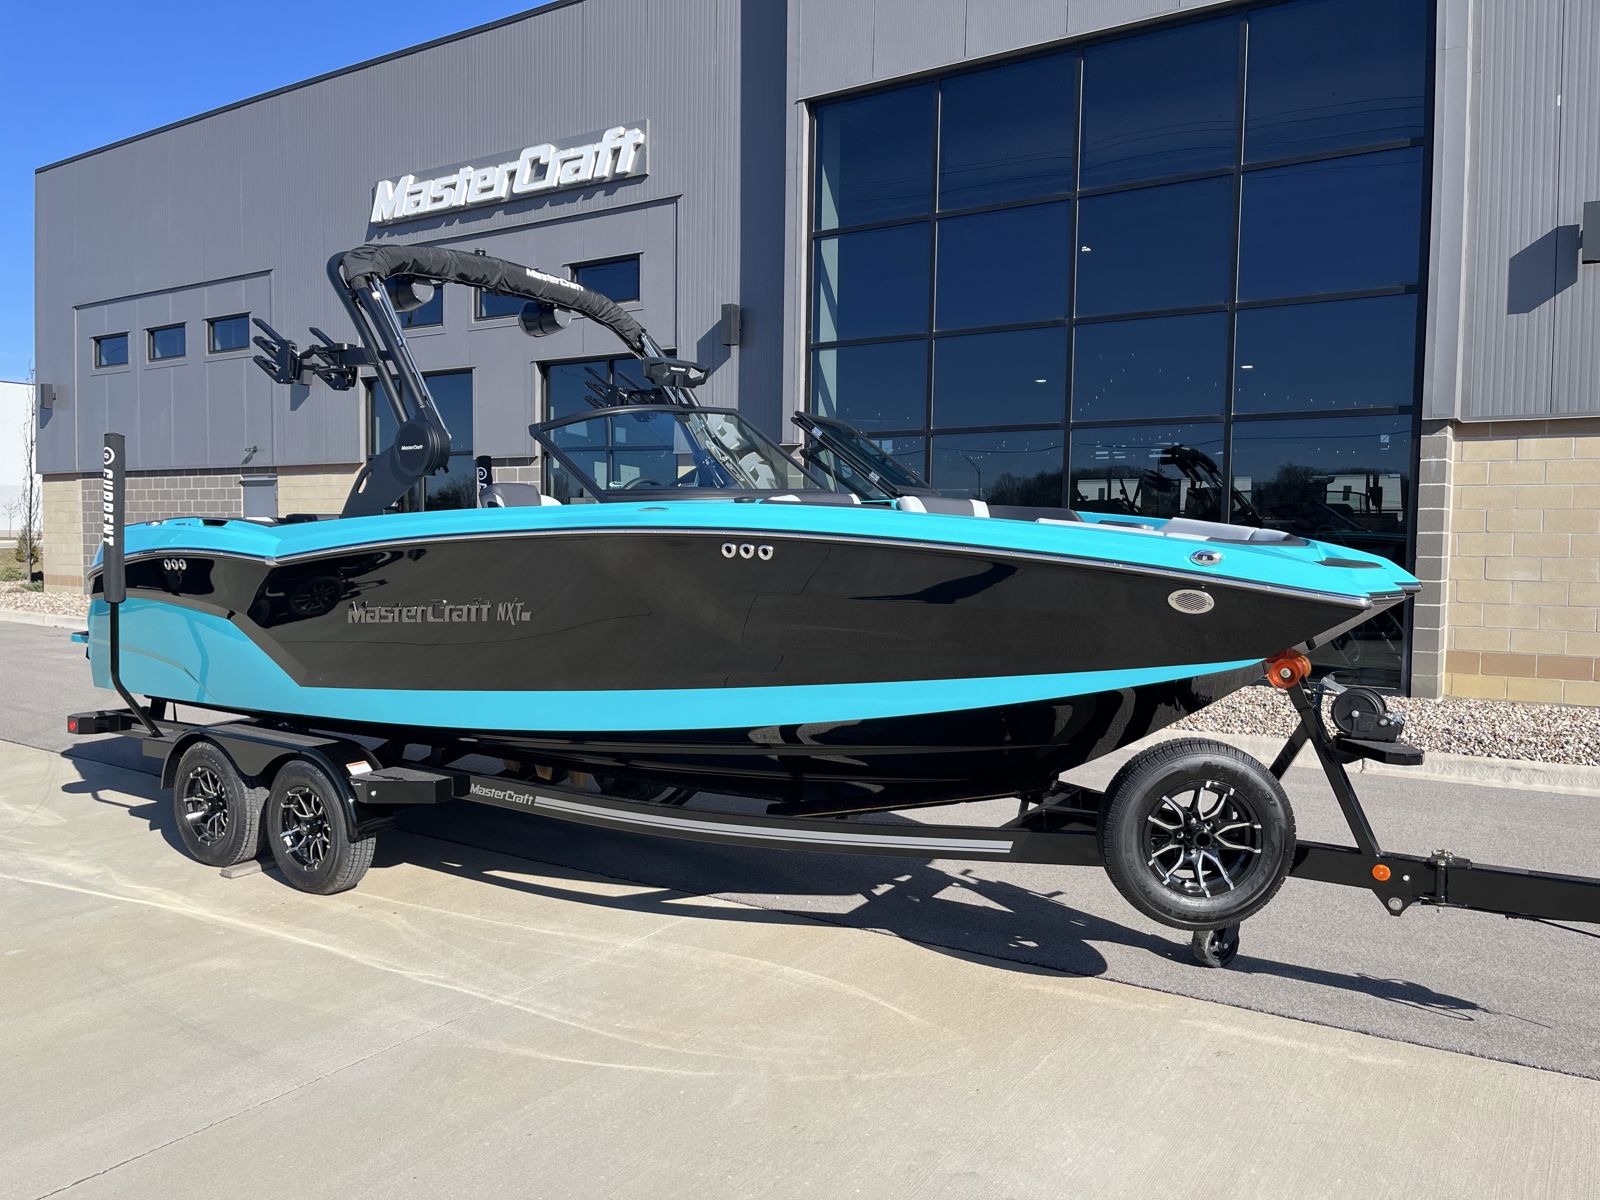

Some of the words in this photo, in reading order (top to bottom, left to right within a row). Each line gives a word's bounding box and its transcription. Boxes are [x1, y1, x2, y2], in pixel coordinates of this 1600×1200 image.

[370, 126, 646, 223] MasterCraft
[347, 598, 492, 624] MasterCraft
[469, 782, 535, 806] MasterCraft
